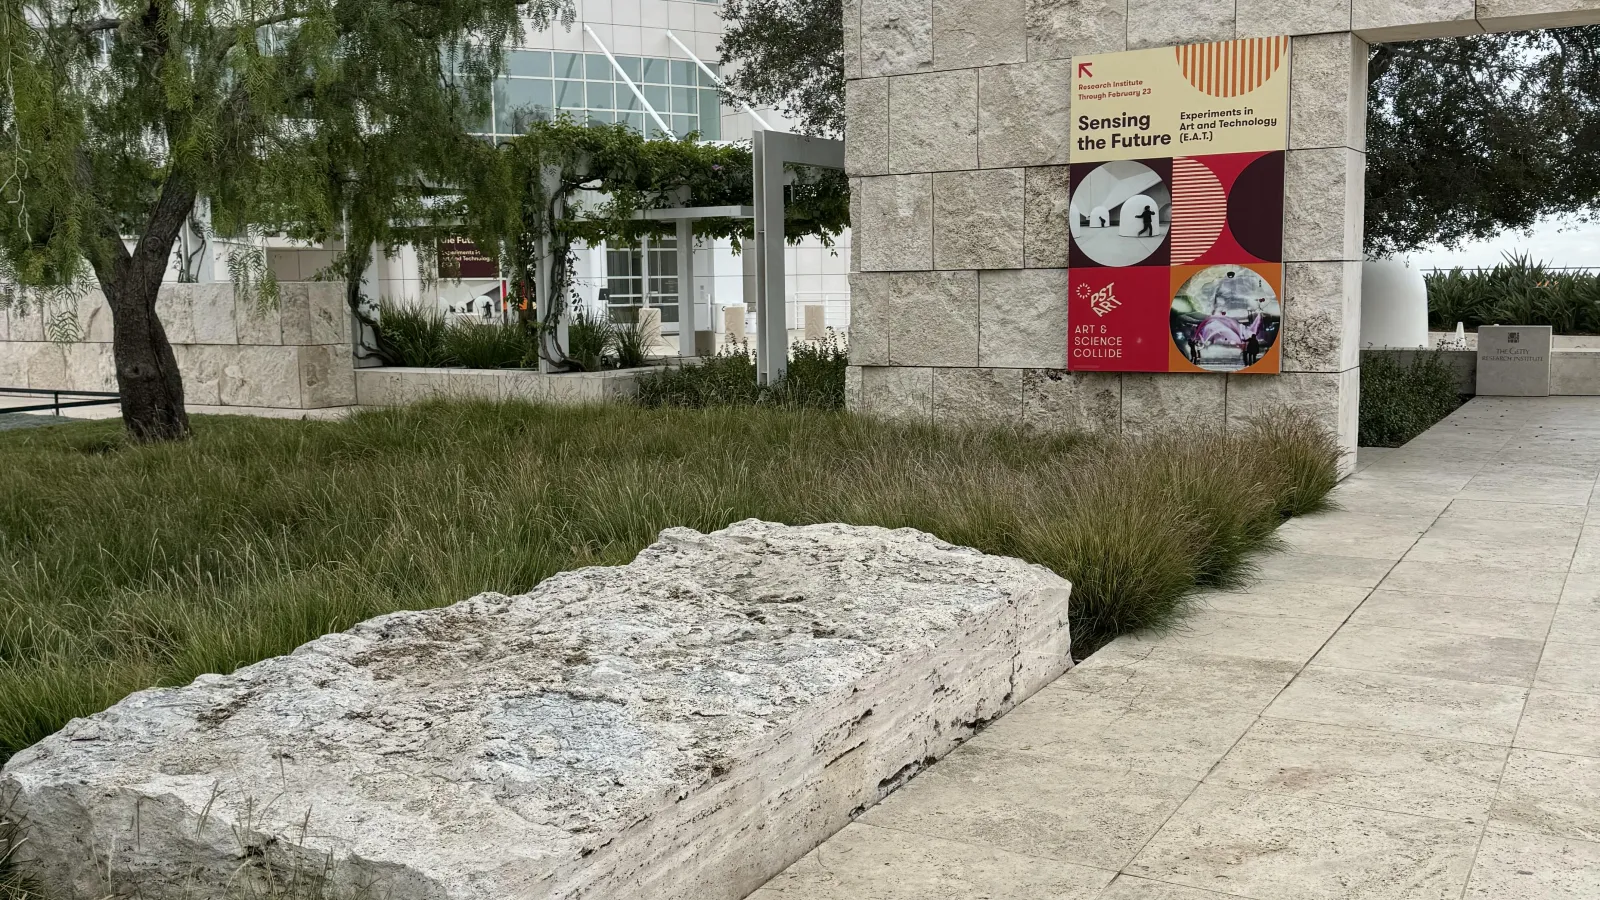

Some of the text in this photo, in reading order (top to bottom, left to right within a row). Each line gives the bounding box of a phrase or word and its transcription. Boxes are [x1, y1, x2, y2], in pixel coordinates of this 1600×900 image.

[1078, 79, 1144, 90] Research Institute
[1078, 87, 1152, 101] Through February 23
[1180, 106, 1254, 121] Experiments in
[1078, 111, 1151, 131] Sensing
[1179, 117, 1278, 131] Art and Technology
[1077, 133, 1172, 151] the Future
[1091, 282, 1115, 307] PST
[1092, 295, 1122, 317] ART
[1074, 324, 1107, 334] ART &
[1074, 336, 1123, 346] SCIENCE
[1073, 348, 1123, 358] COLLIDE
